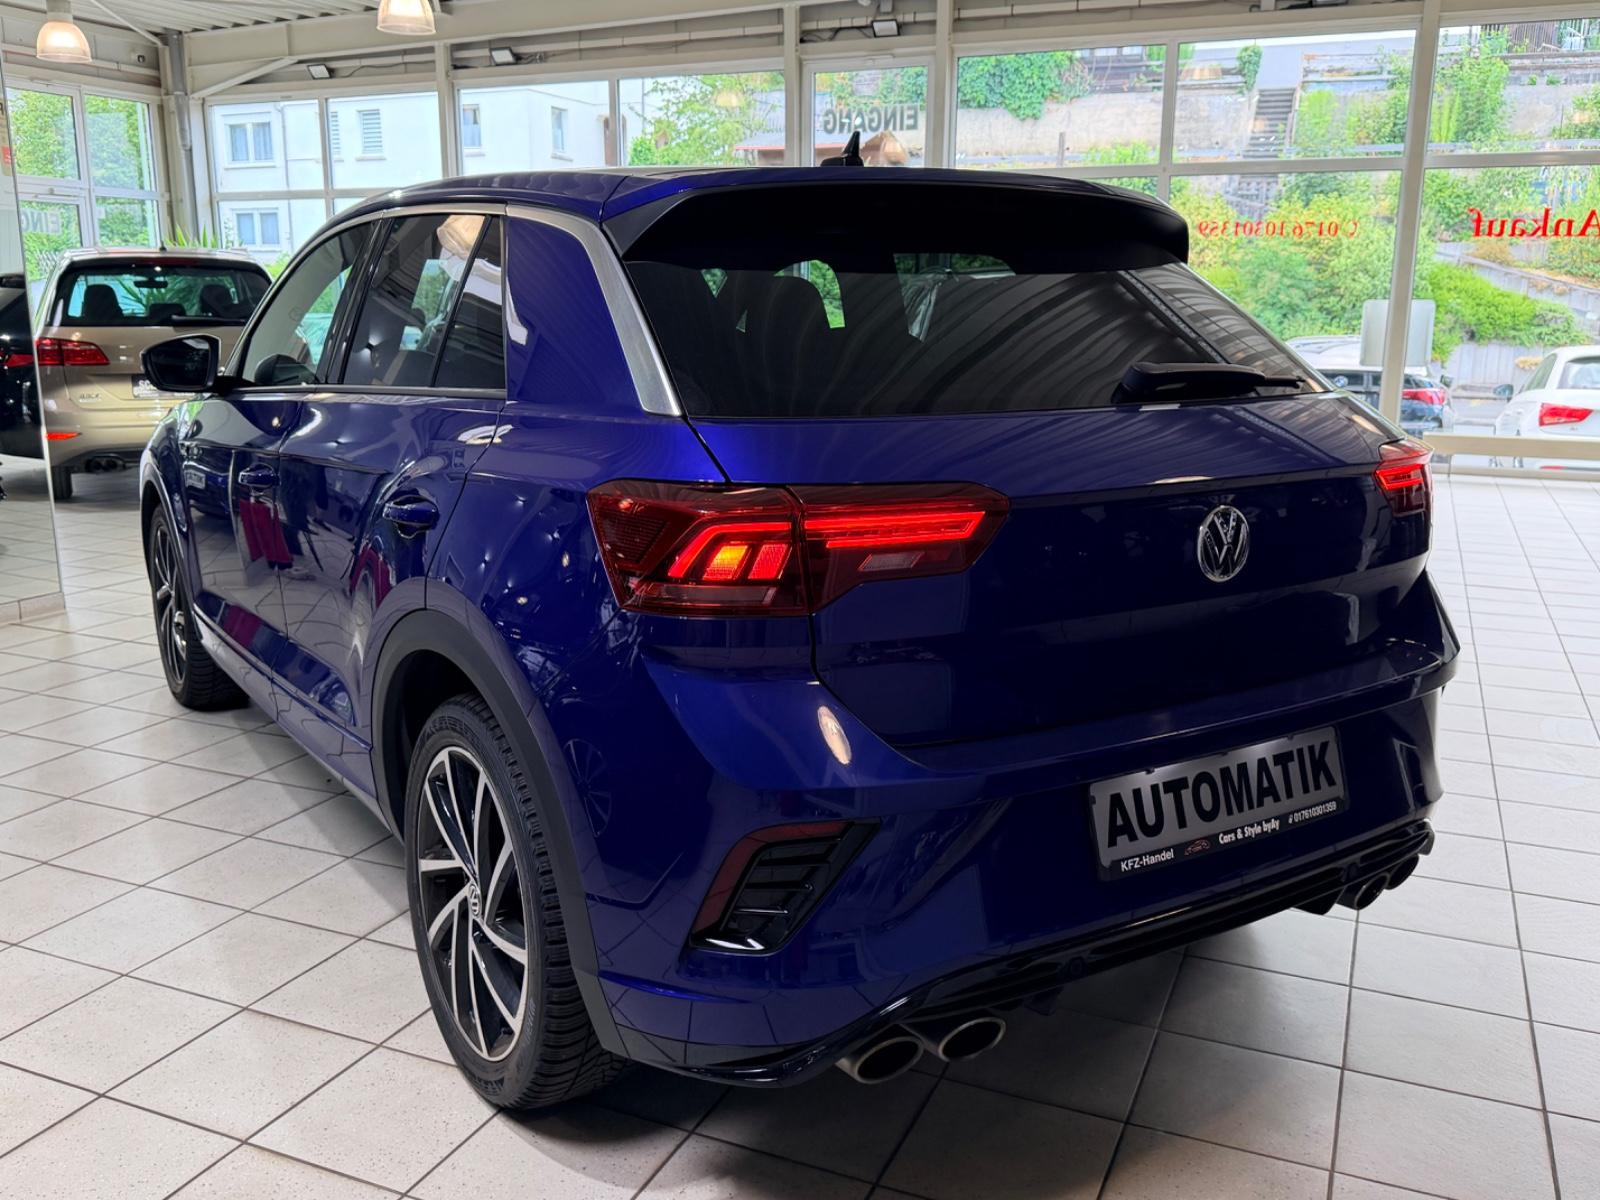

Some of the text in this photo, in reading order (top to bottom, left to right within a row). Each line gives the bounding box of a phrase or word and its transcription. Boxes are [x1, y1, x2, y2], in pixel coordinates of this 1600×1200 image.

[1107, 741, 1336, 848] AUTOMATIK
[1121, 849, 1174, 872] KFZ-Handel
[1218, 832, 1236, 845] Cars
[1236, 828, 1243, 840] &
